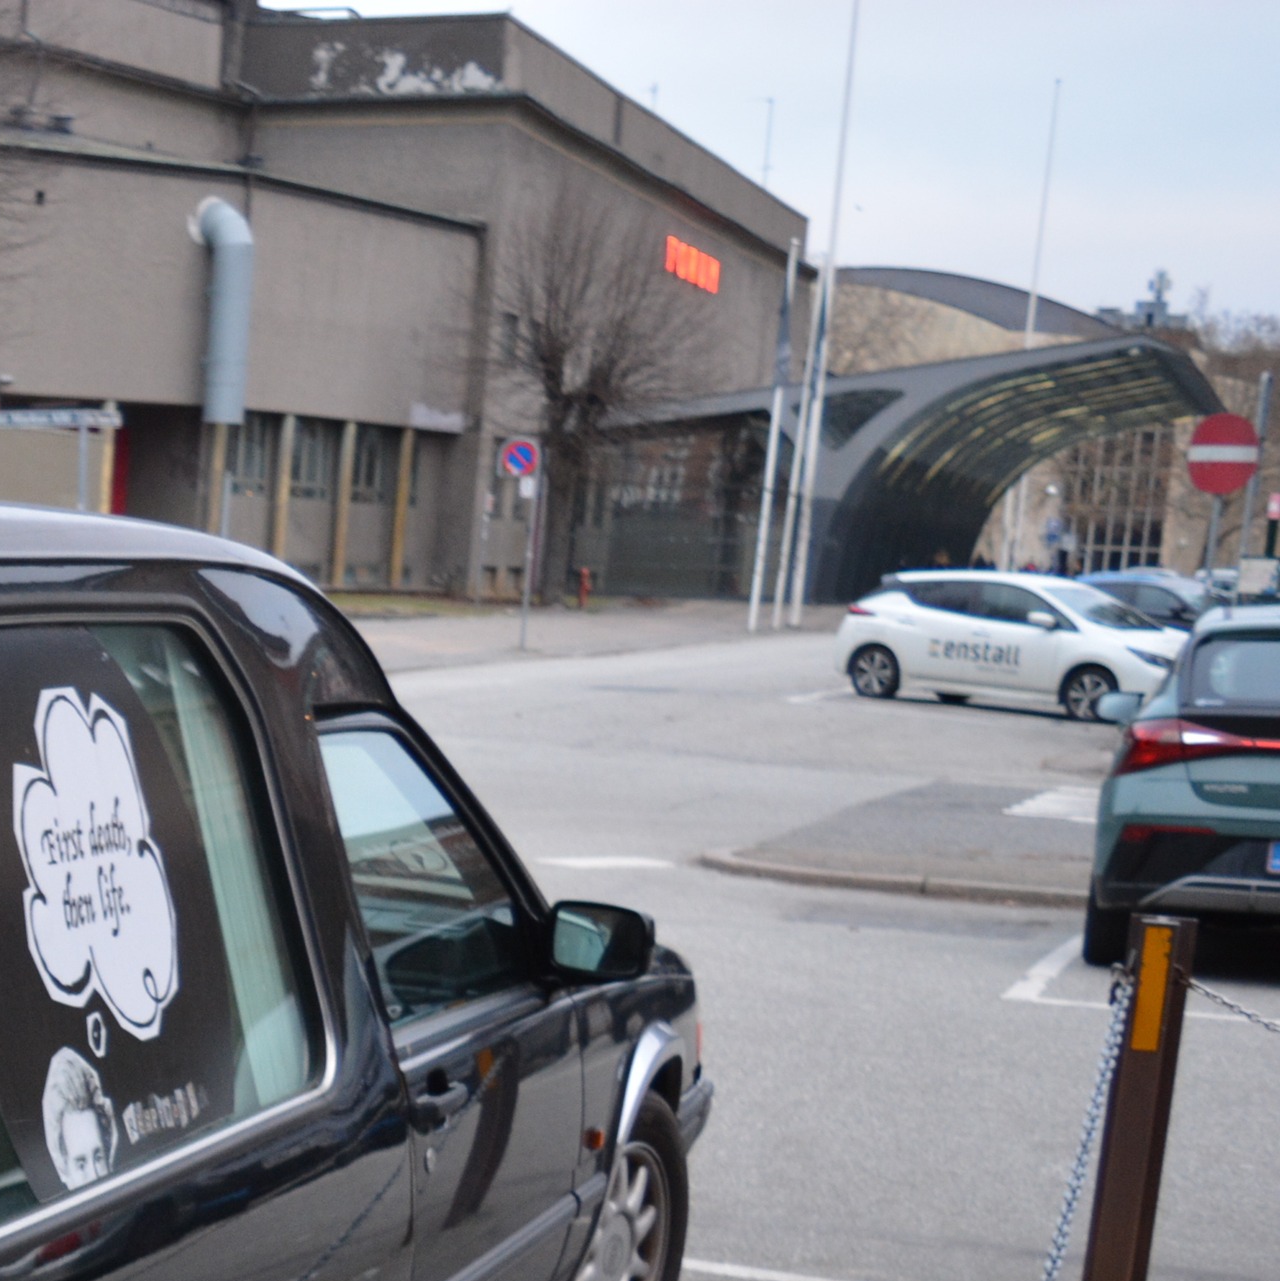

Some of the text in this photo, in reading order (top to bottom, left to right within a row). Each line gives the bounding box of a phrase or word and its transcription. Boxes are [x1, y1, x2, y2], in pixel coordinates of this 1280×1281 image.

[40, 796, 132, 866] First death,
[62, 862, 131, 938] then life.
